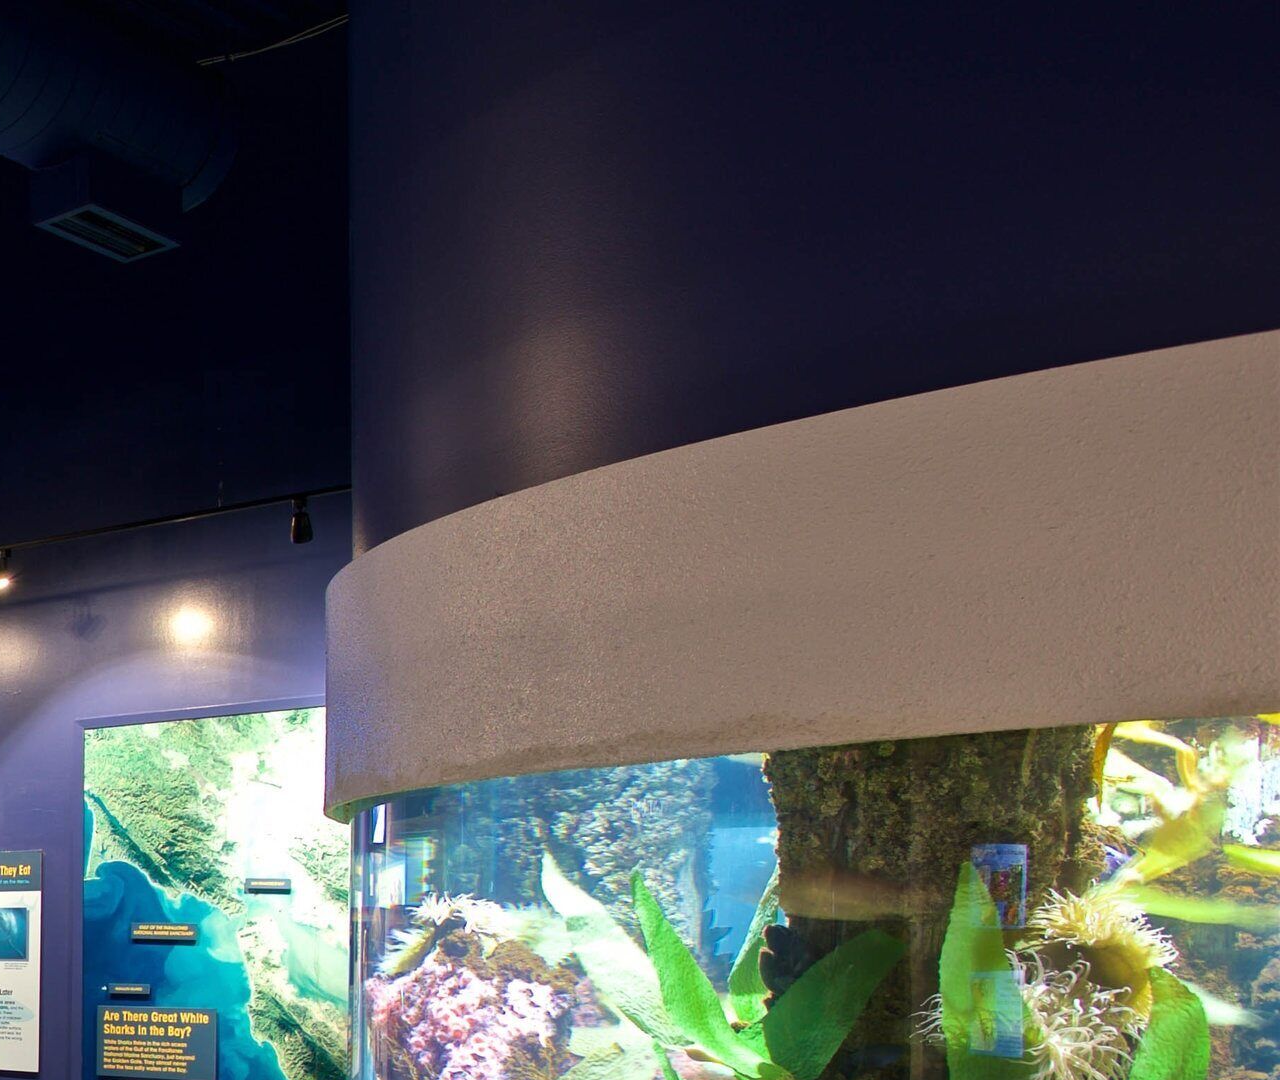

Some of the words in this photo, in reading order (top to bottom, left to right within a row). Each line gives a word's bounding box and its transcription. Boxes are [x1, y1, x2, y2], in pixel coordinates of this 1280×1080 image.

[0, 864, 18, 878] They
[18, 864, 31, 876] Eat
[0, 988, 14, 996] Later
[103, 1010, 120, 1021] Are
[122, 1010, 149, 1022] There
[151, 1011, 178, 1023] Great
[180, 1012, 210, 1024] White
[103, 1023, 135, 1035] Sharks
[149, 1025, 165, 1036] the
[167, 1025, 192, 1039] Bay?
